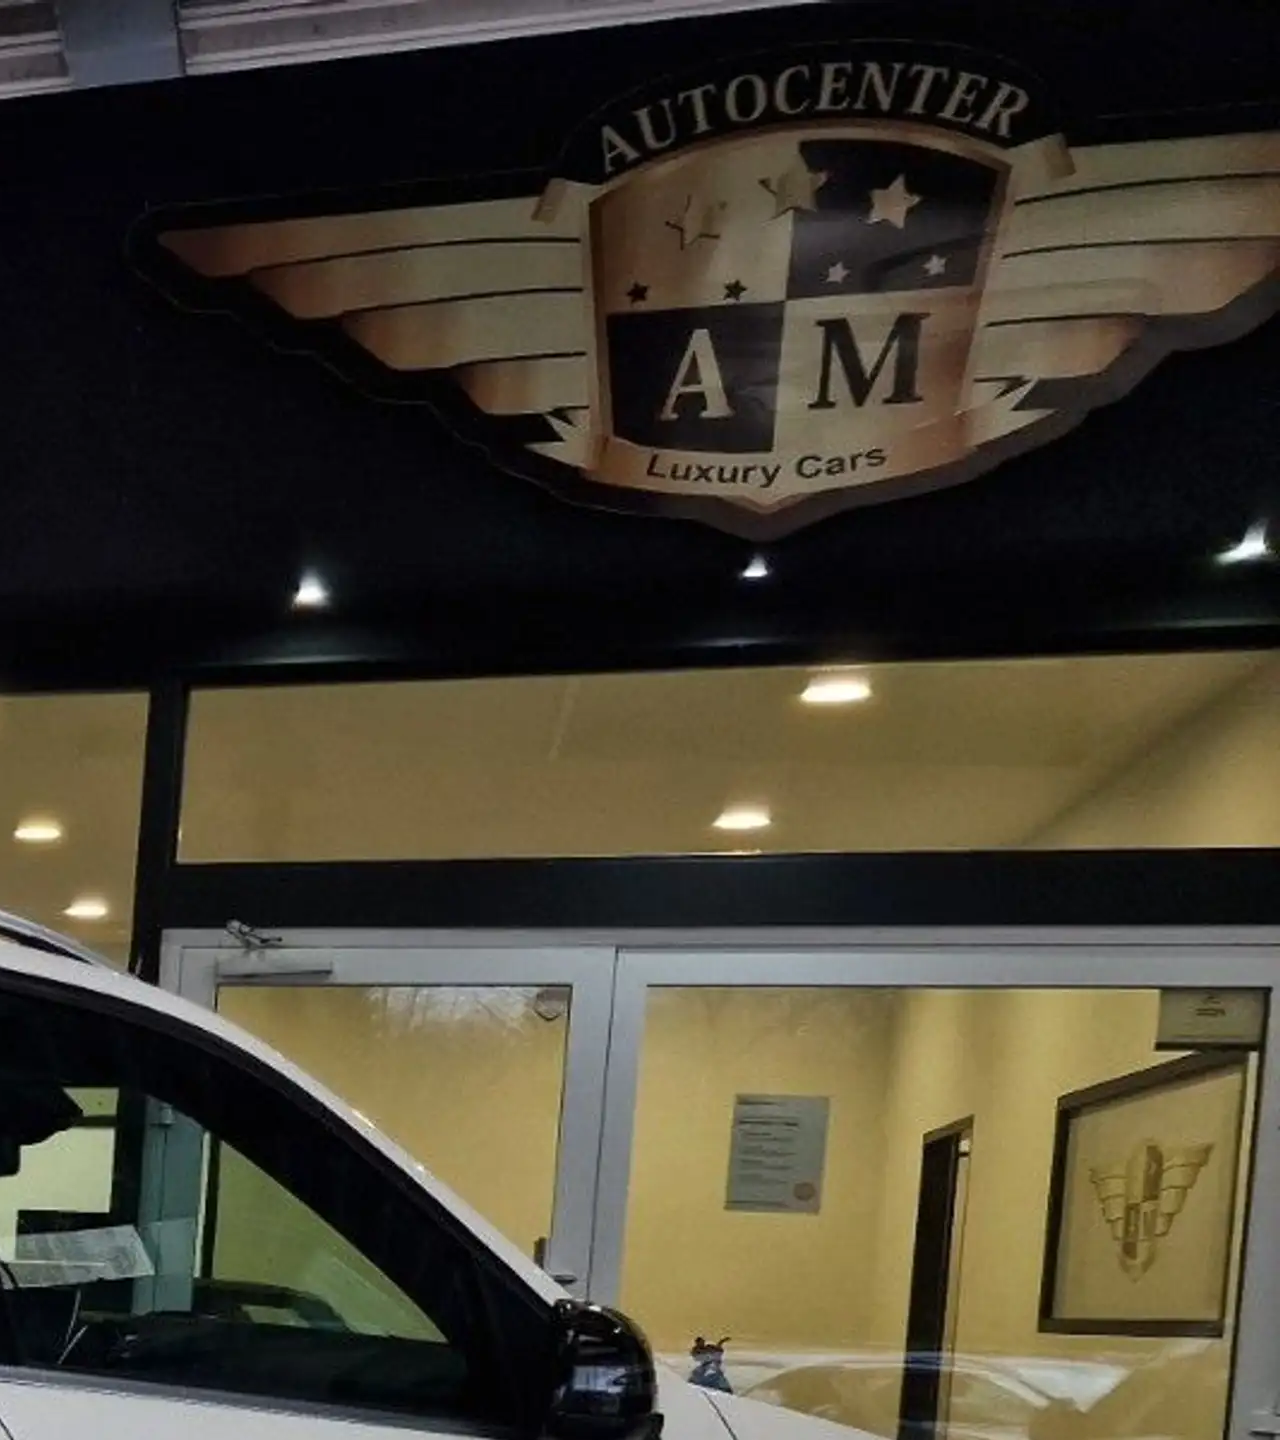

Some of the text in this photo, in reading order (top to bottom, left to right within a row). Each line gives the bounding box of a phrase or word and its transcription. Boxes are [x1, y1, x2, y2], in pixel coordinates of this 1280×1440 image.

[599, 61, 1030, 174] AUTOCENTER
[646, 447, 888, 488] Luxury Cars
